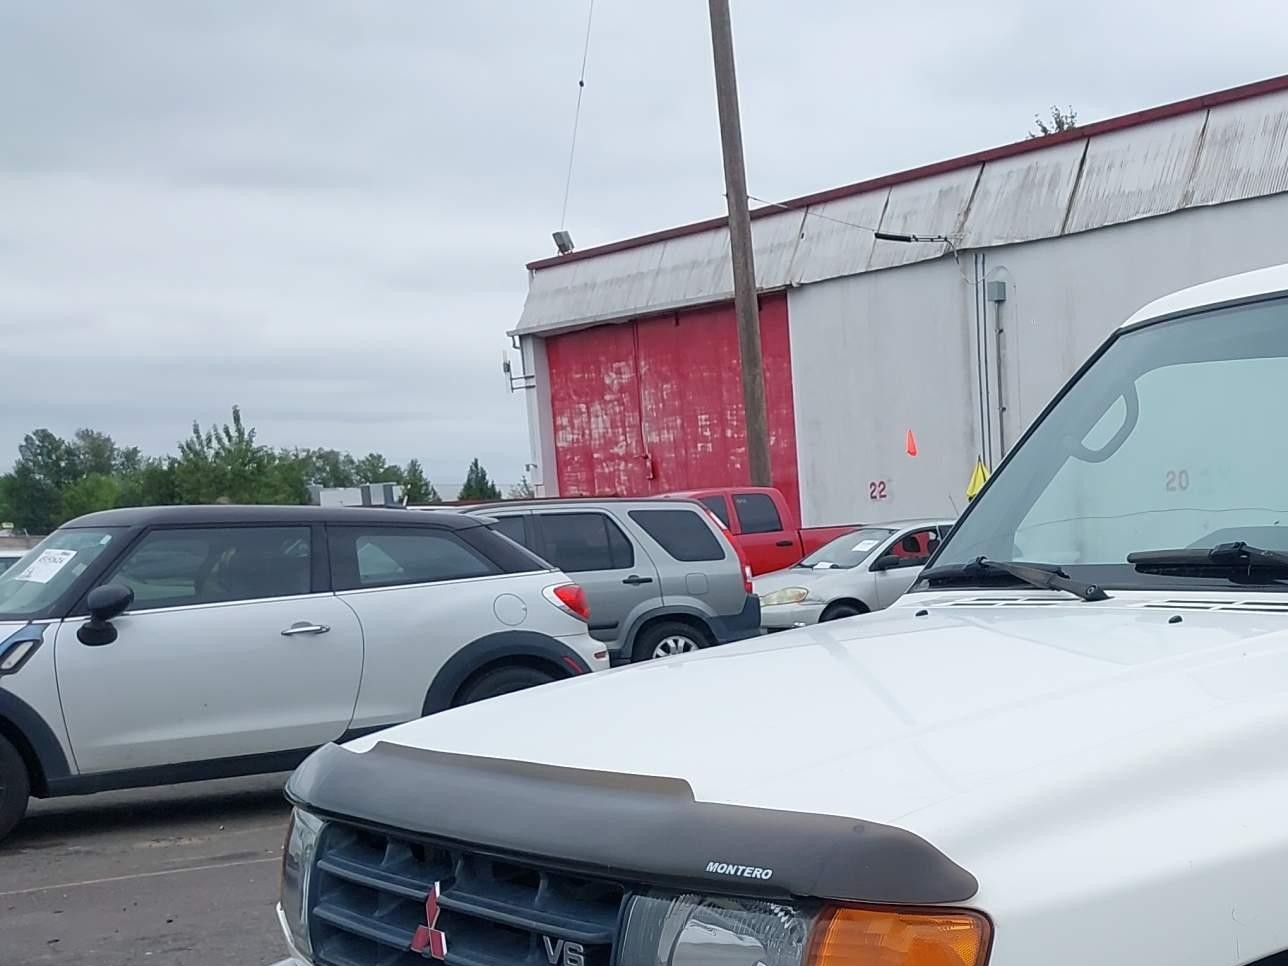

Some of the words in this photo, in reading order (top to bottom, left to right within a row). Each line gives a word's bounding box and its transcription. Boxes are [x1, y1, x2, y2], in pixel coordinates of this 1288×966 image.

[870, 481, 887, 499] 22
[1166, 470, 1189, 491] 20
[706, 861, 773, 880] MONTERO
